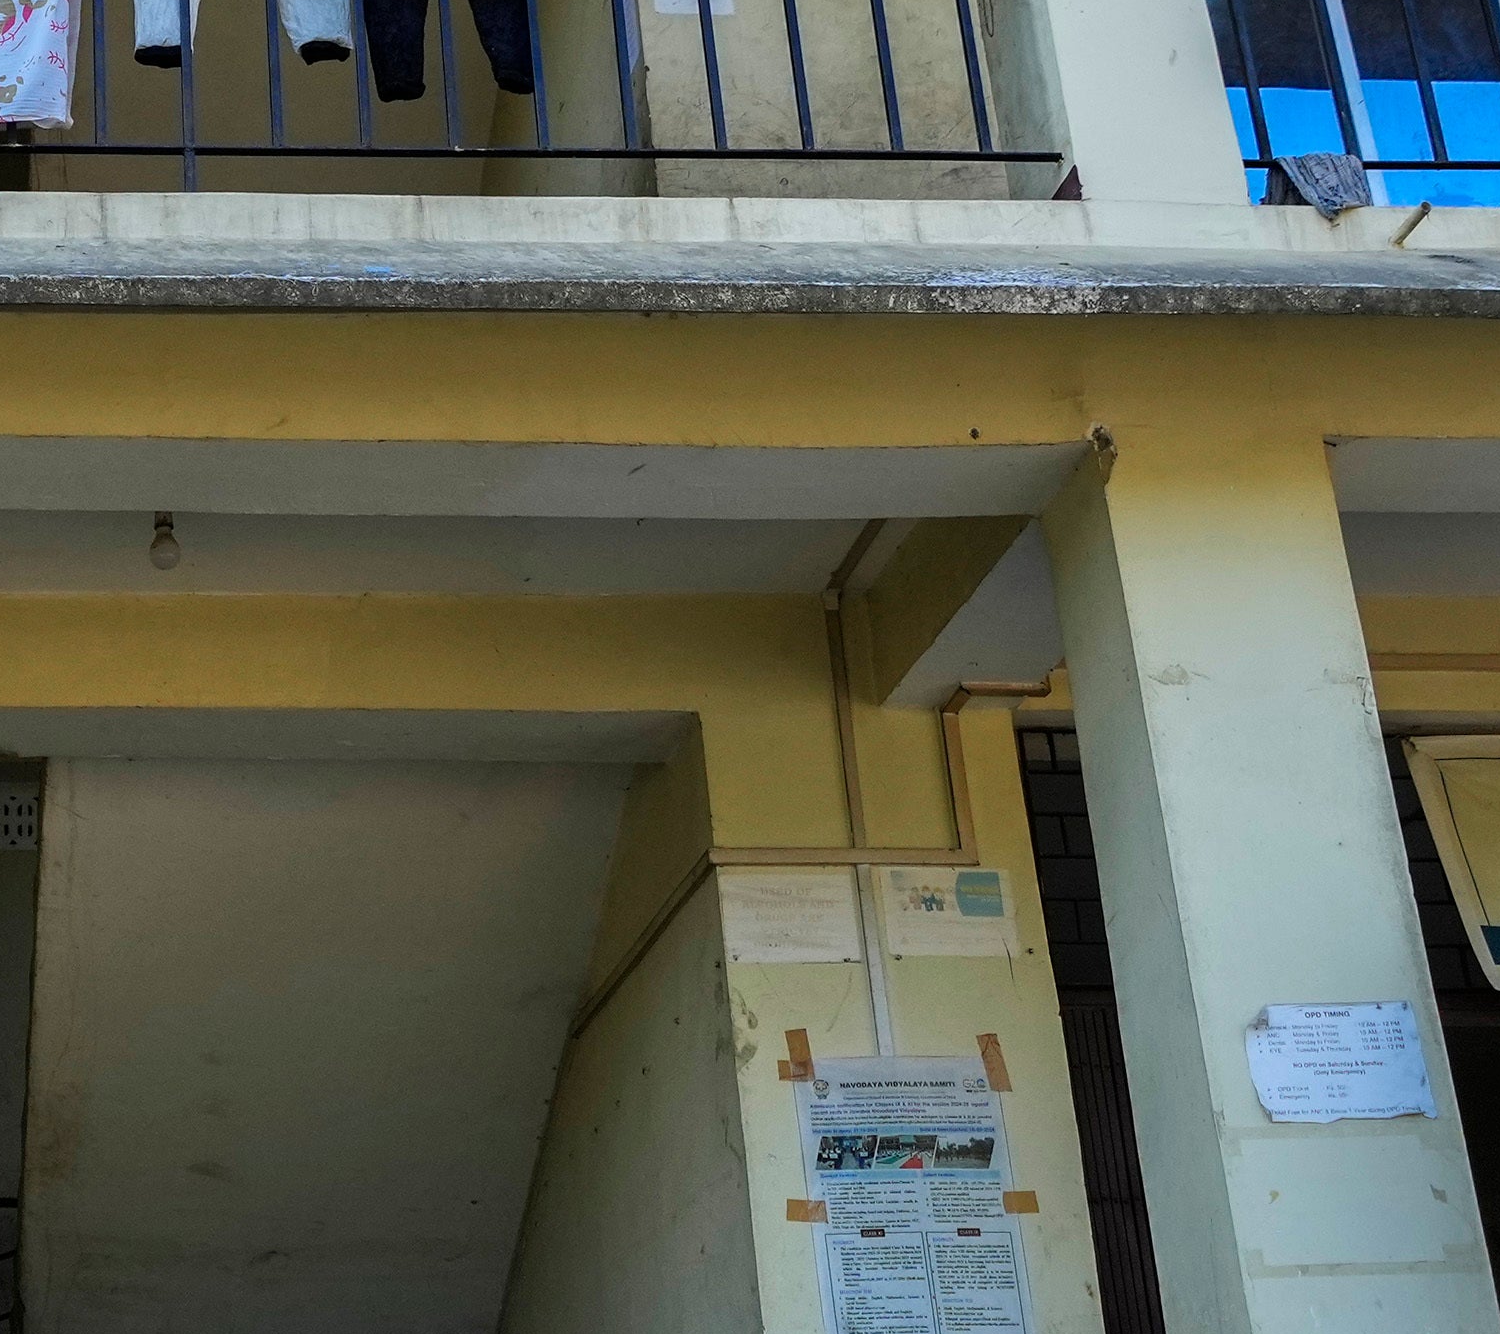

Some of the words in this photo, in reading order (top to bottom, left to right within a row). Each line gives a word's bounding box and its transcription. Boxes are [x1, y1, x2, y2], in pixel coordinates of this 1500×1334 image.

[1304, 1011, 1322, 1019] OPD
[1324, 1010, 1351, 1018] TIMING
[884, 1080, 929, 1088] VIDYALAYA
[930, 1080, 956, 1088] SAMITI
